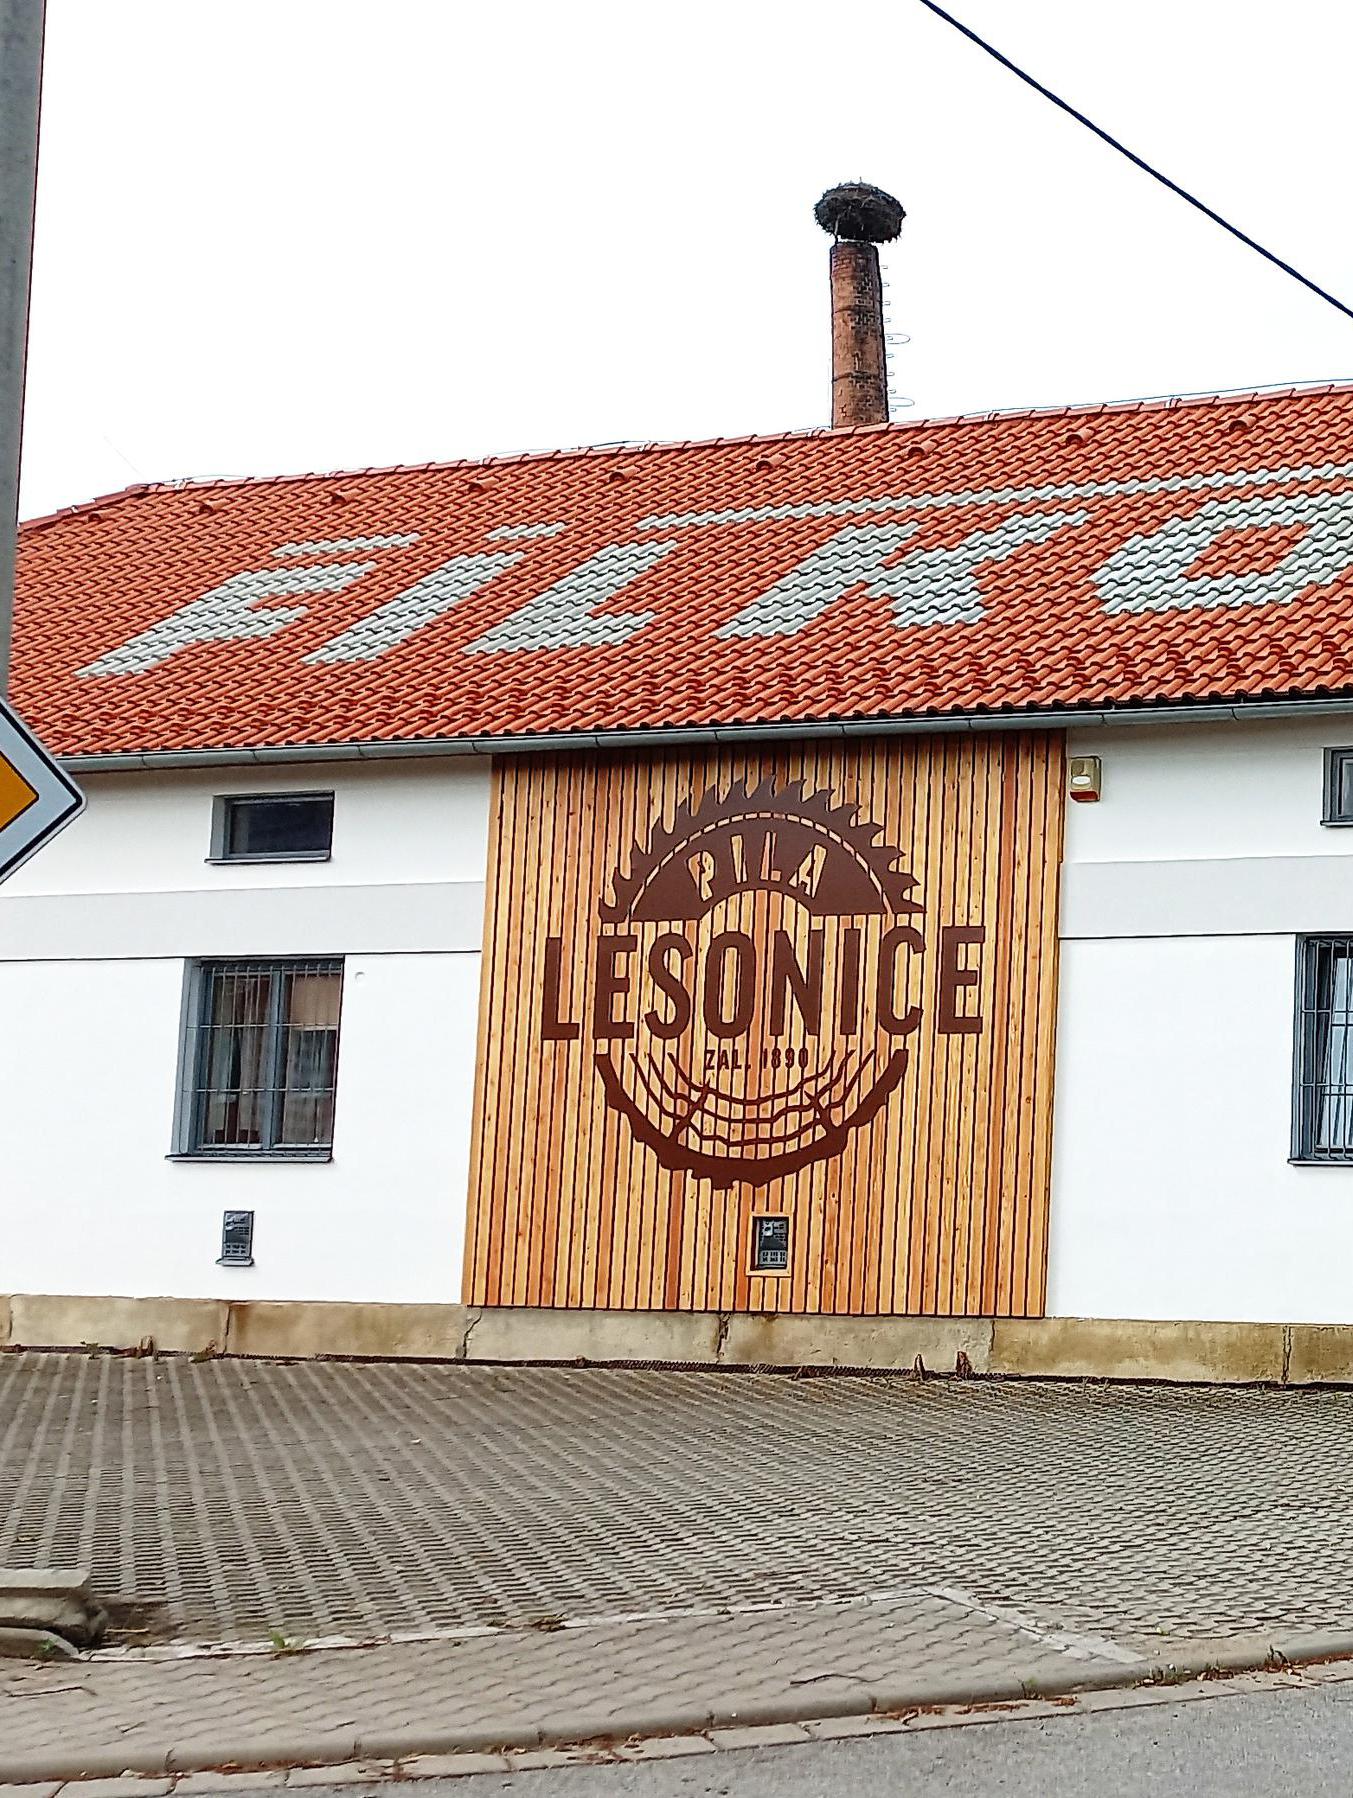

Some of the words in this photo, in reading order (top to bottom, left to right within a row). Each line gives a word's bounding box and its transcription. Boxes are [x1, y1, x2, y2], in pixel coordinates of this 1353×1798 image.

[686, 831, 828, 902] PILA
[540, 924, 987, 1042] LESONICE
[704, 1048, 752, 1070] ZAL.
[762, 1047, 809, 1069] 1890
